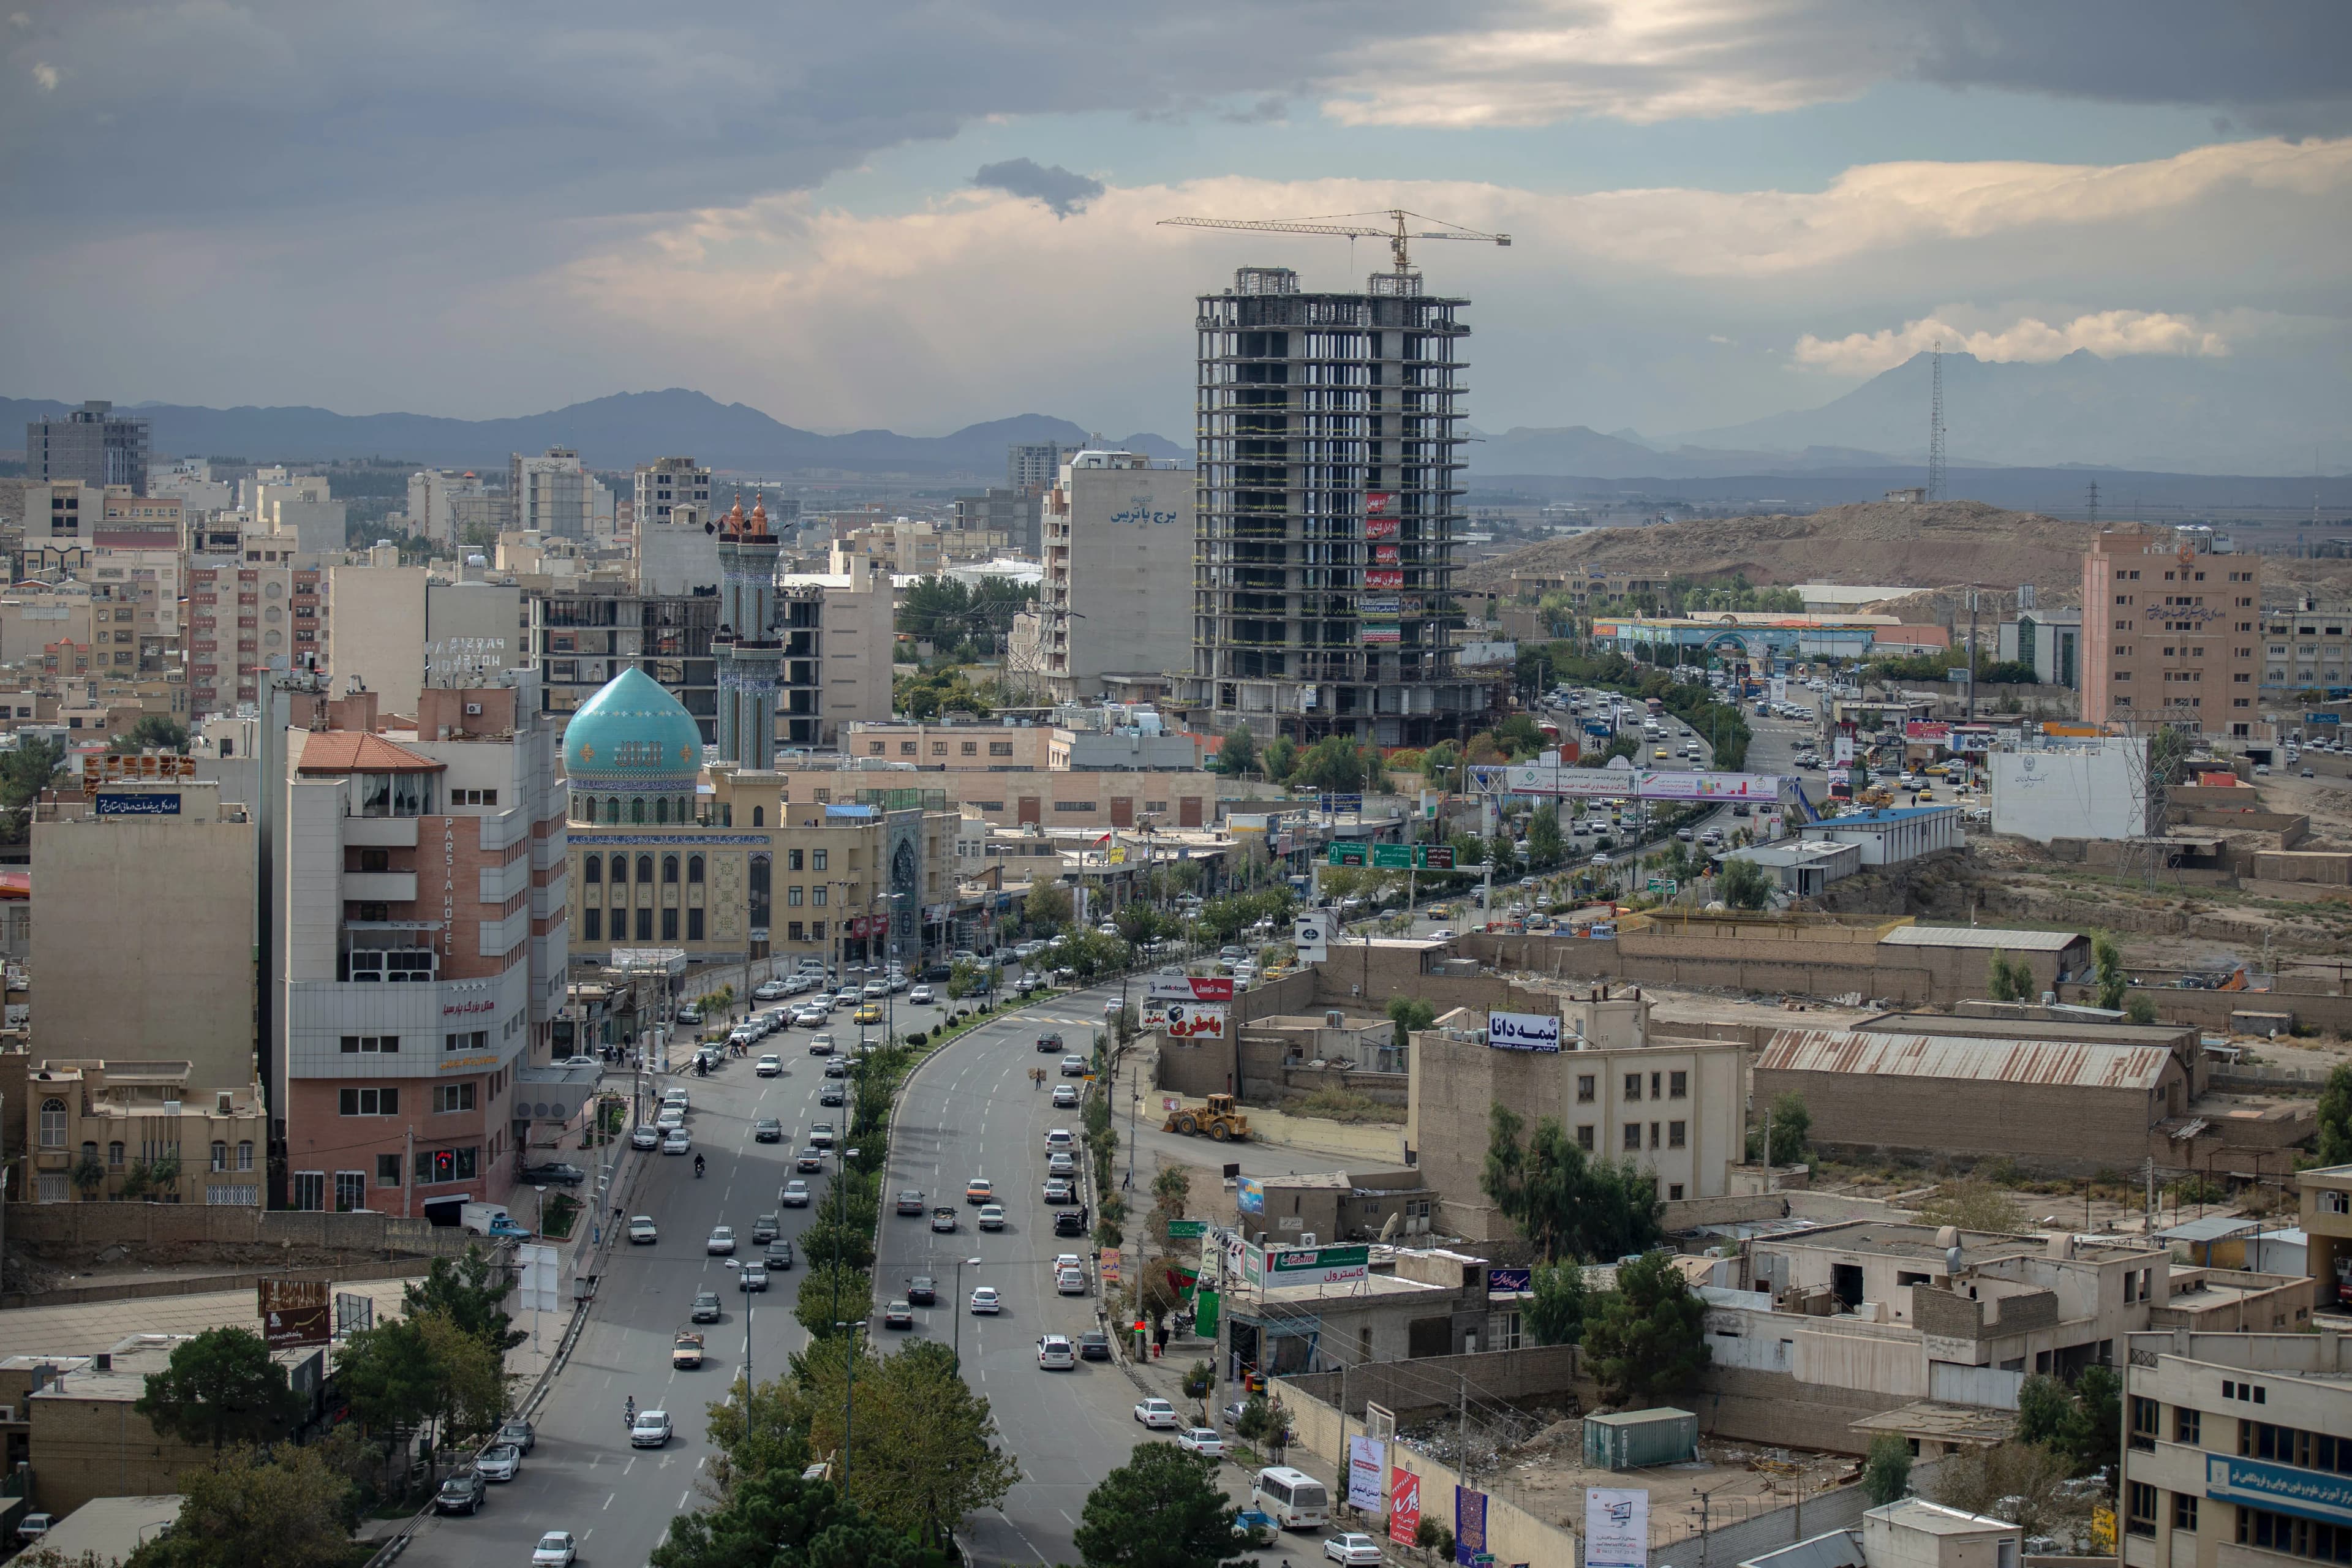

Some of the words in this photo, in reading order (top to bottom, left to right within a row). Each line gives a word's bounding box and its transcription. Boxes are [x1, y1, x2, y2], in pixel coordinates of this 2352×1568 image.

[1110, 507, 1150, 524] پاتریس
[1153, 511, 1177, 523] برج
[1382, 573, 1394, 586] قرن
[1394, 574, 1403, 586] نیم
[100, 799, 108, 814] قم
[104, 801, 121, 812] استان
[120, 802, 135, 813] درمانی
[134, 801, 153, 811] خدمات
[157, 799, 168, 813] کل
[445, 818, 453, 891] PARSIA
[444, 895, 453, 956] HOTEL
[442, 1003, 463, 1016] پارسیا
[464, 1000, 480, 1012] بزرگ
[481, 1000, 494, 1012] هتل
[1169, 1016, 1221, 1037] باطری
[1491, 1017, 1515, 1037] دانا
[1517, 1024, 1558, 1046] بیمه
[1289, 1253, 1316, 1264] Castrol
[1324, 1267, 1364, 1282] کاسترول
[2232, 1469, 2240, 1481] قم
[2239, 1472, 2266, 1487] فرودگاهی
[1351, 1483, 1366, 1494] اصفهانی
[2270, 1478, 2288, 1491] هوایی
[2287, 1481, 2301, 1493] فنون
[2305, 1484, 2319, 1497] علوم
[1366, 1488, 1380, 1498] احمدی
[2318, 1487, 2341, 1501] آموزش
